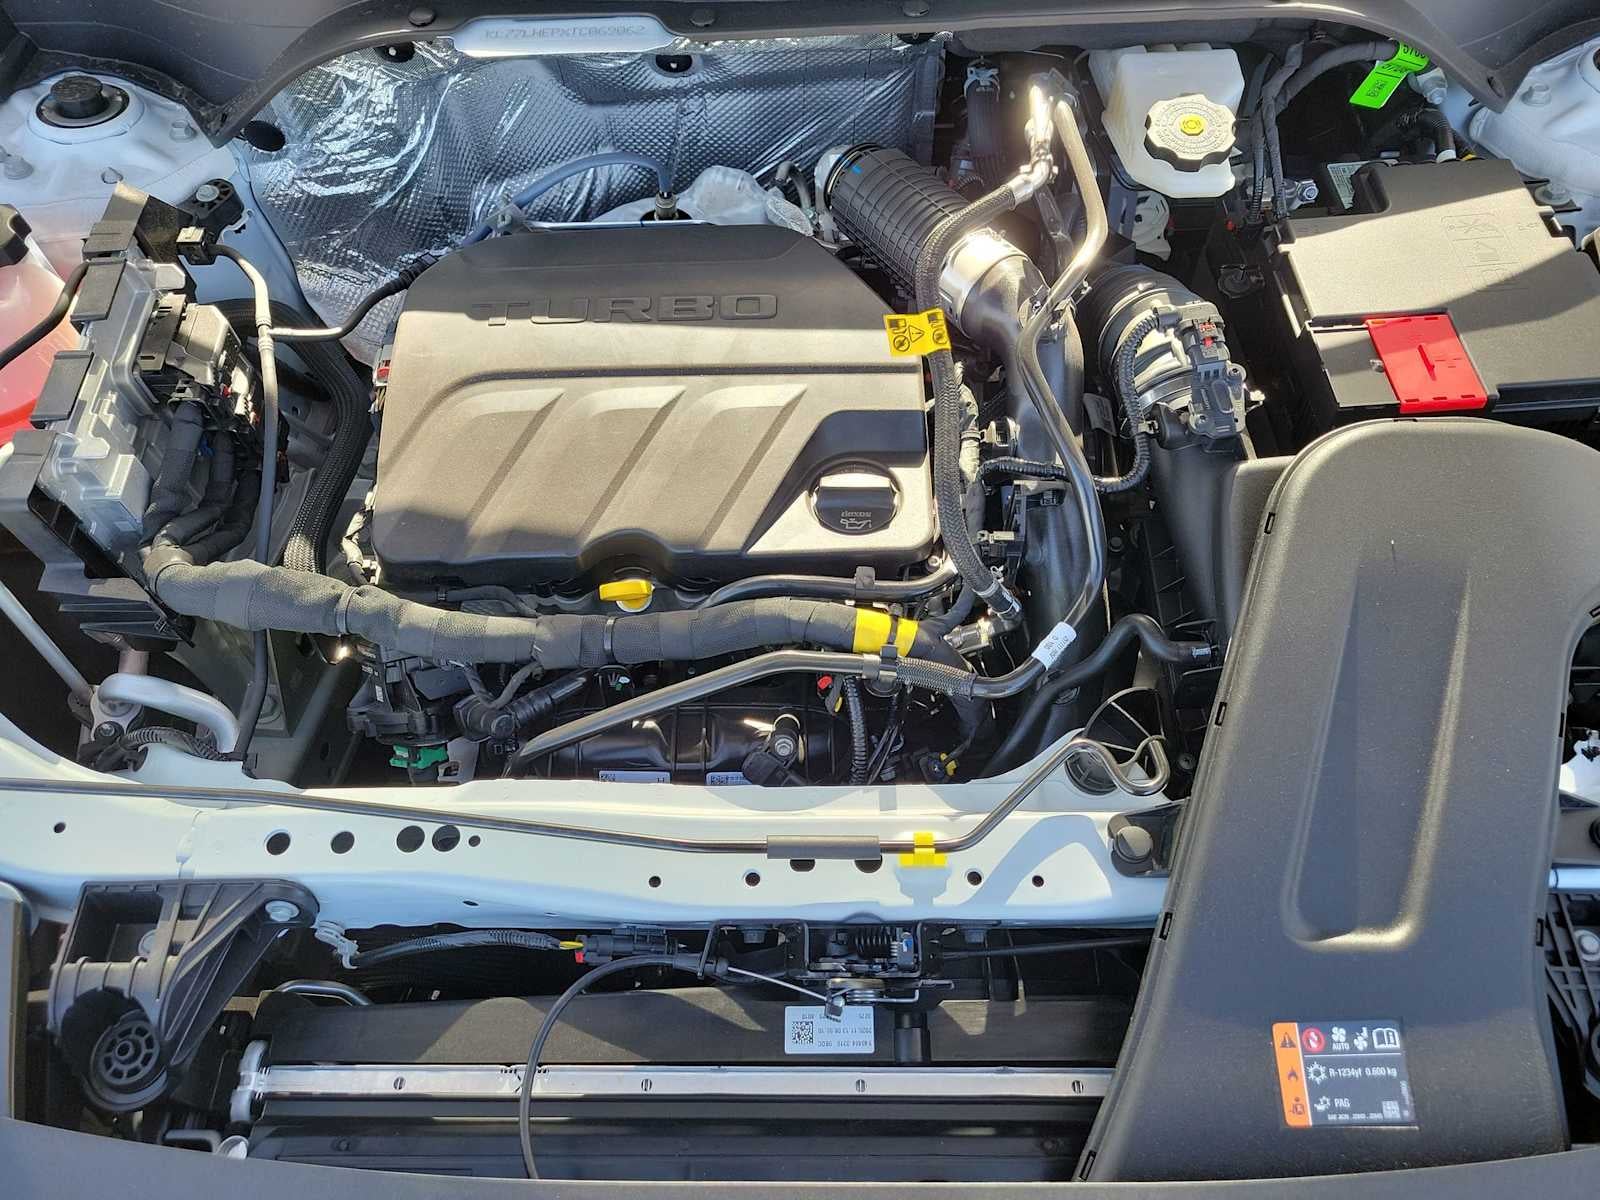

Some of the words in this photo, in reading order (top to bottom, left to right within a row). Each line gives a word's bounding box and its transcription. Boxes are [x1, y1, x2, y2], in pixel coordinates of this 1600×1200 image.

[472, 294, 778, 326] TURBO
[1332, 1042, 1350, 1050] AUTO
[1387, 1066, 1397, 1077] kg
[1334, 1098, 1350, 1108] PAG
